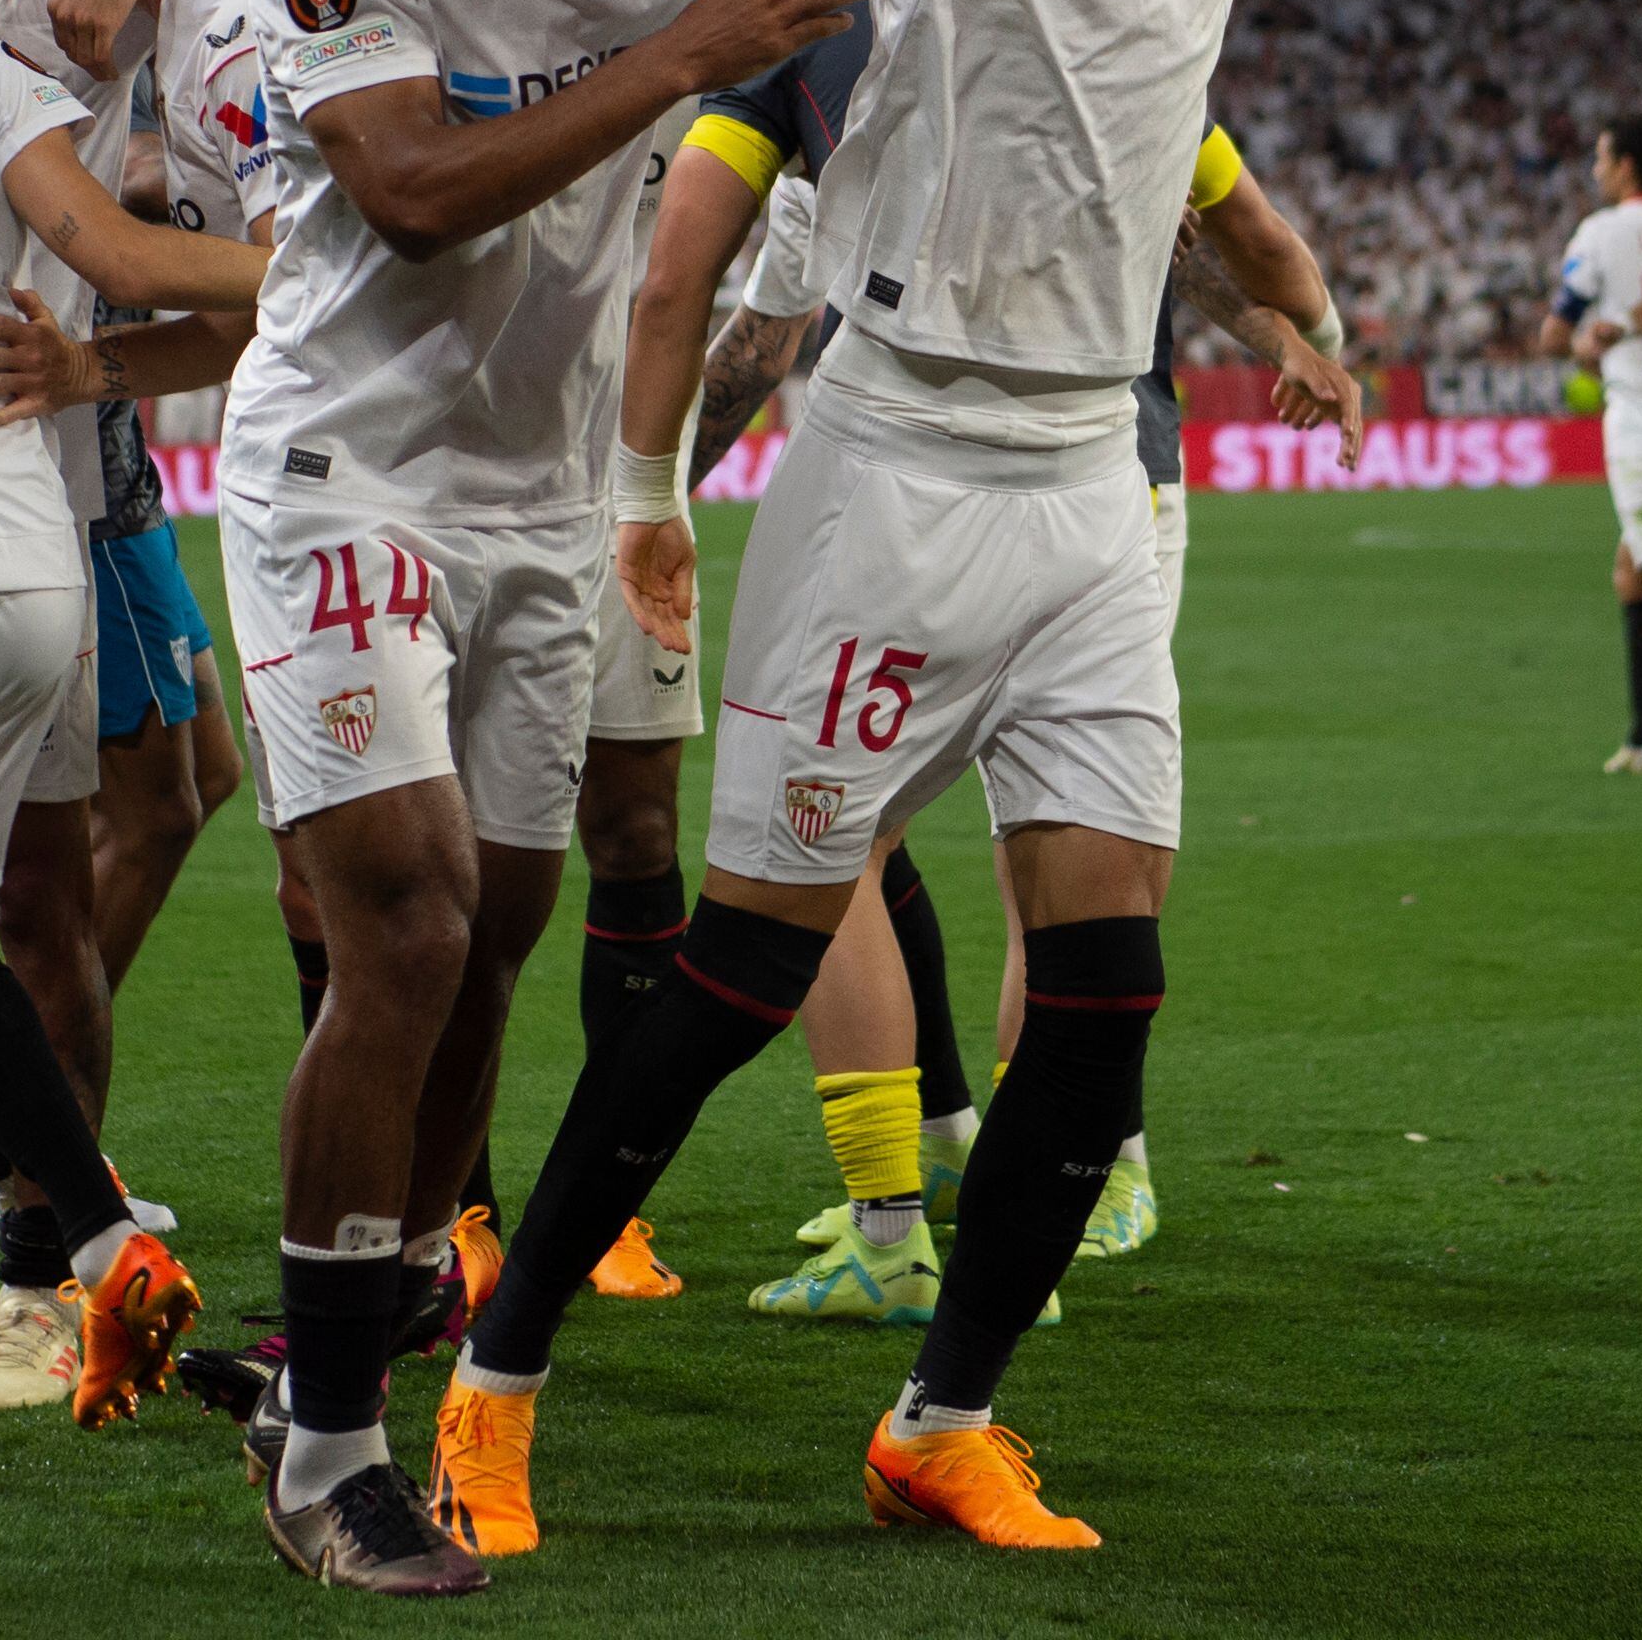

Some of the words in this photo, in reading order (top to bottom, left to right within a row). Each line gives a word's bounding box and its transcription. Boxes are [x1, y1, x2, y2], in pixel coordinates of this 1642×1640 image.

[295, 27, 393, 71] FOUNDATION
[1207, 417, 1553, 492] STRAUSS
[309, 540, 431, 653] 44
[815, 636, 929, 753] 15
